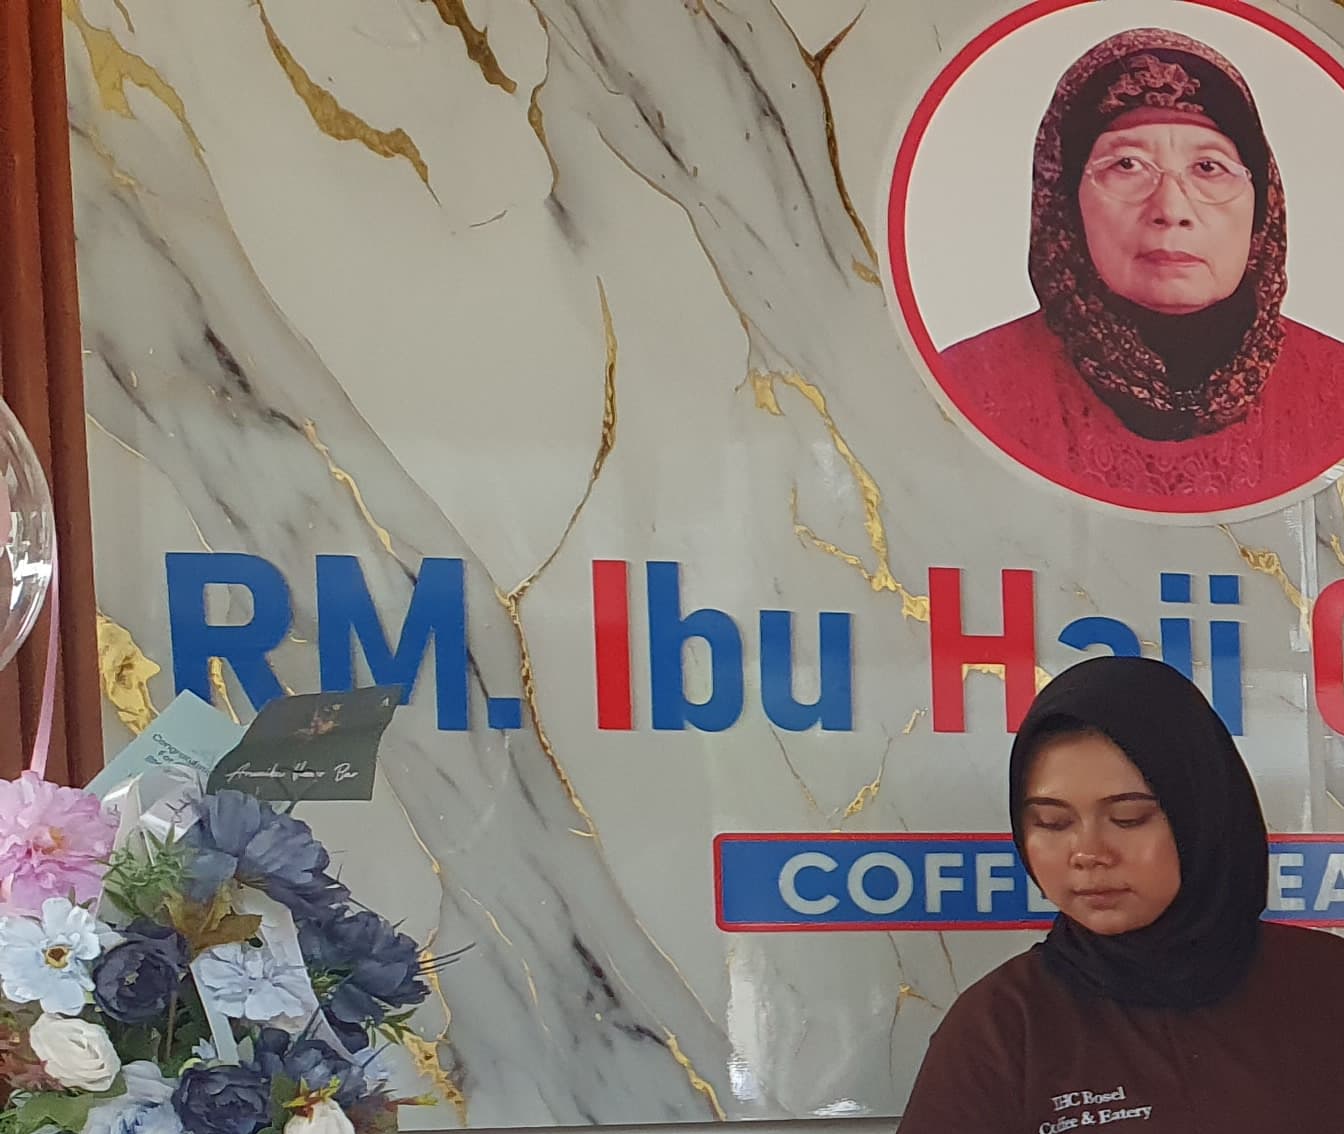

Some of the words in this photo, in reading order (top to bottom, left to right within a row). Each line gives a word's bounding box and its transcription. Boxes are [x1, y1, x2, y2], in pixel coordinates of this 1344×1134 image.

[164, 552, 522, 732] RM.
[592, 559, 854, 733] Ibu
[777, 851, 1062, 914] COFF
[1081, 1110, 1097, 1125] &
[1098, 1106, 1153, 1124] Eatery
